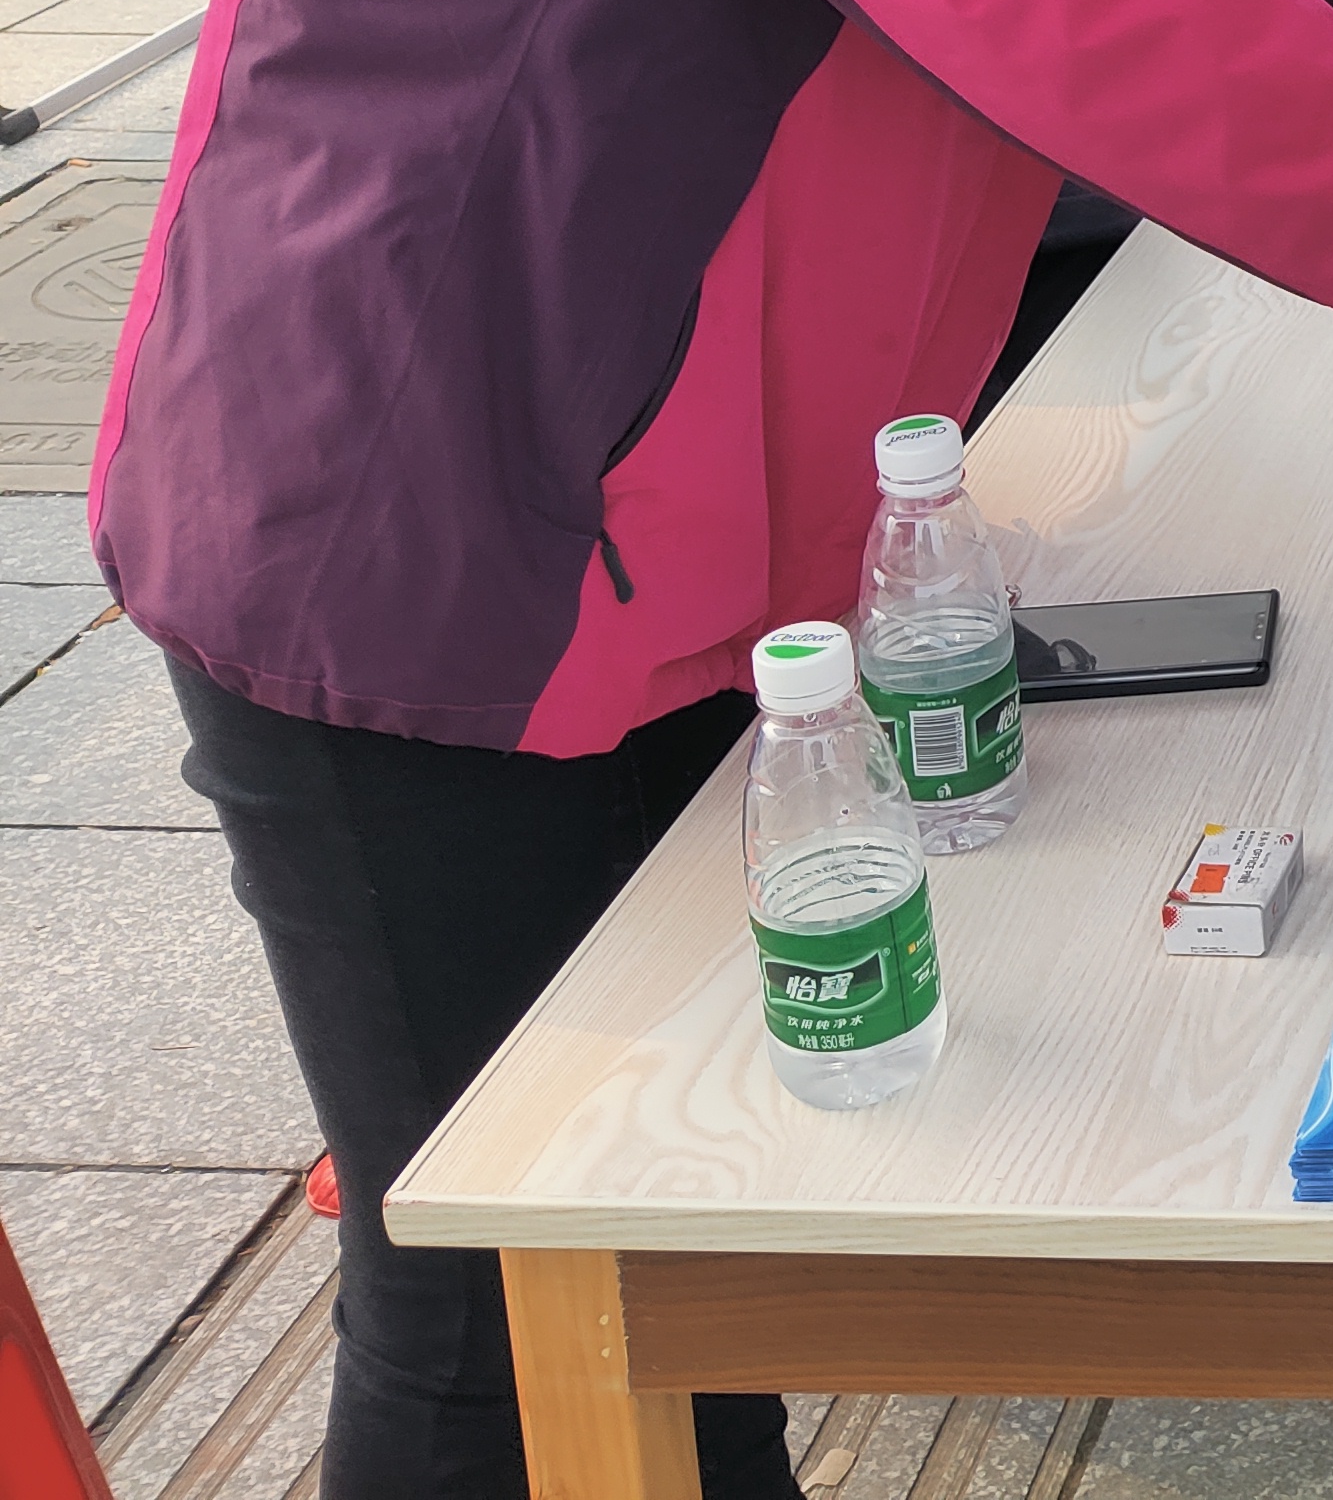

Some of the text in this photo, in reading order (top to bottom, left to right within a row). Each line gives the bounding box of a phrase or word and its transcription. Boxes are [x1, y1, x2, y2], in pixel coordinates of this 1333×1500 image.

[785, 970, 856, 1004] 怡寶
[786, 1014, 865, 1031] 饮用纯净水
